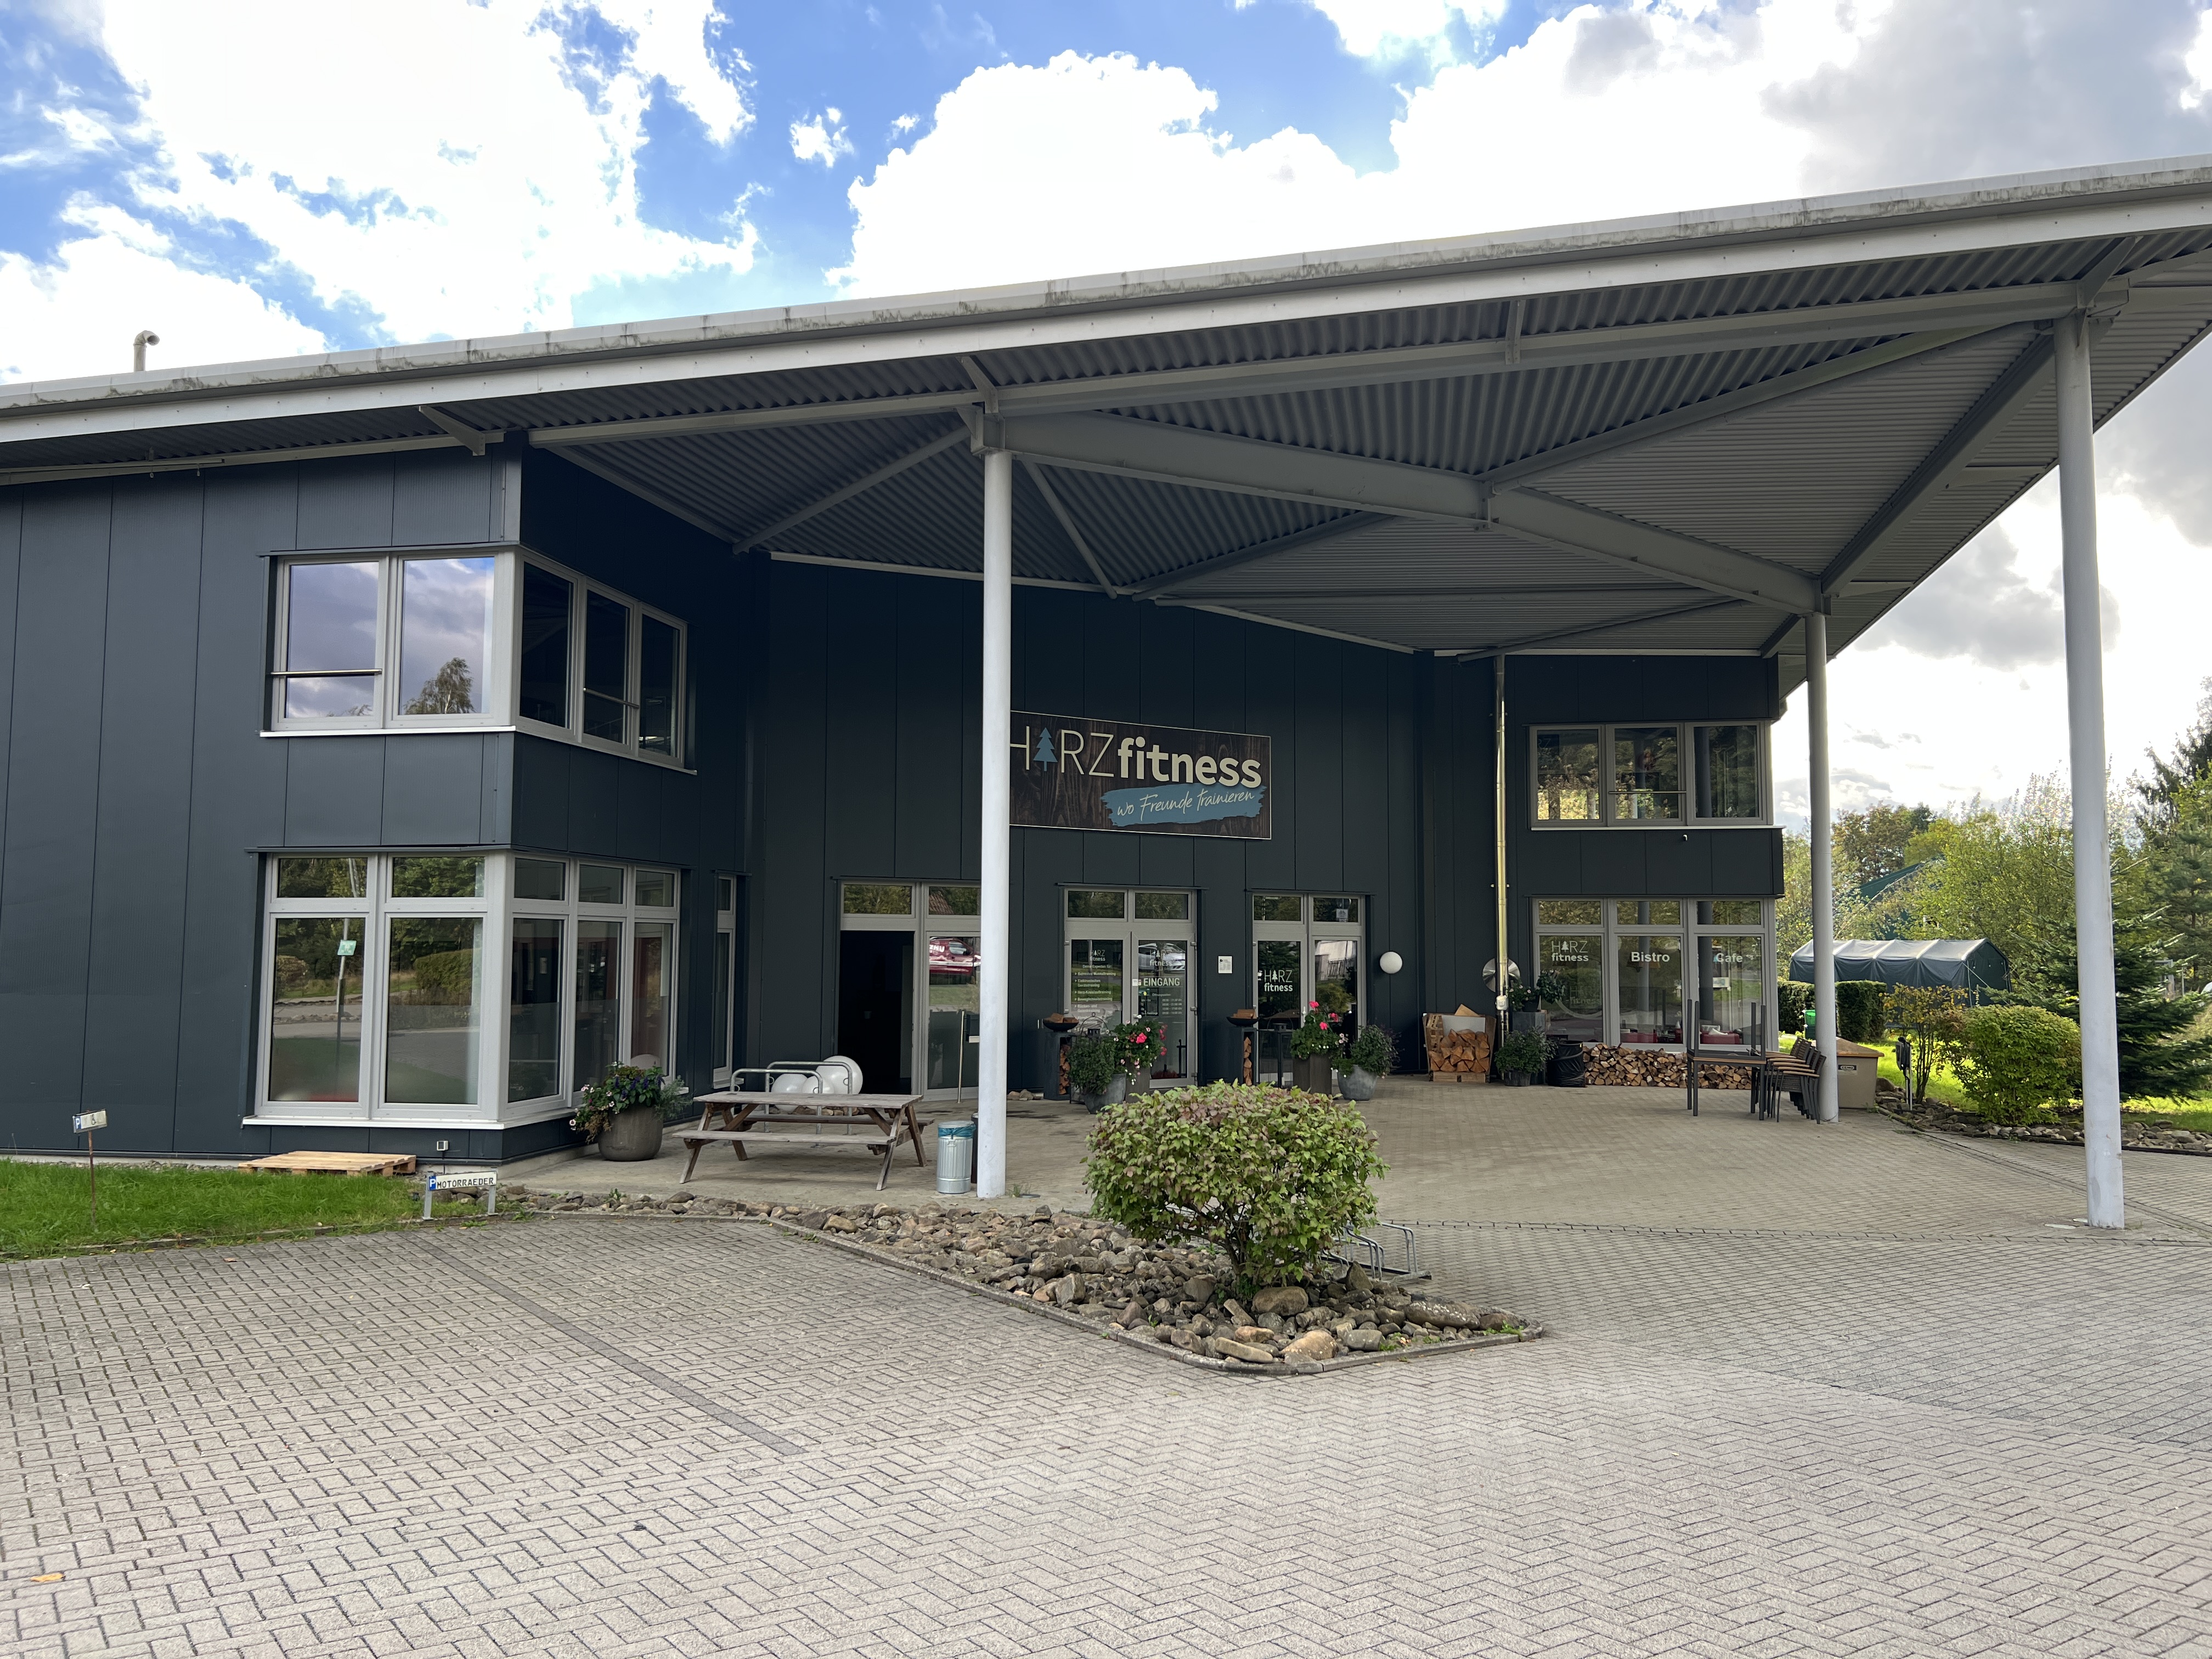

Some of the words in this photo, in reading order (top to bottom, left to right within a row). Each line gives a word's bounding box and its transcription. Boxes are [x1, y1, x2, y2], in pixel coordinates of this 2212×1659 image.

[1118, 802, 1134, 816] wo
[1139, 791, 1193, 821] Freunde
[1551, 952, 1589, 961] fitness
[1631, 951, 1670, 962] Bistro
[1716, 952, 1743, 963] Cafe
[1143, 978, 1180, 986] EINGANG
[1264, 982, 1293, 991] fitness
[437, 1177, 494, 1189] MOTORRAEDER
